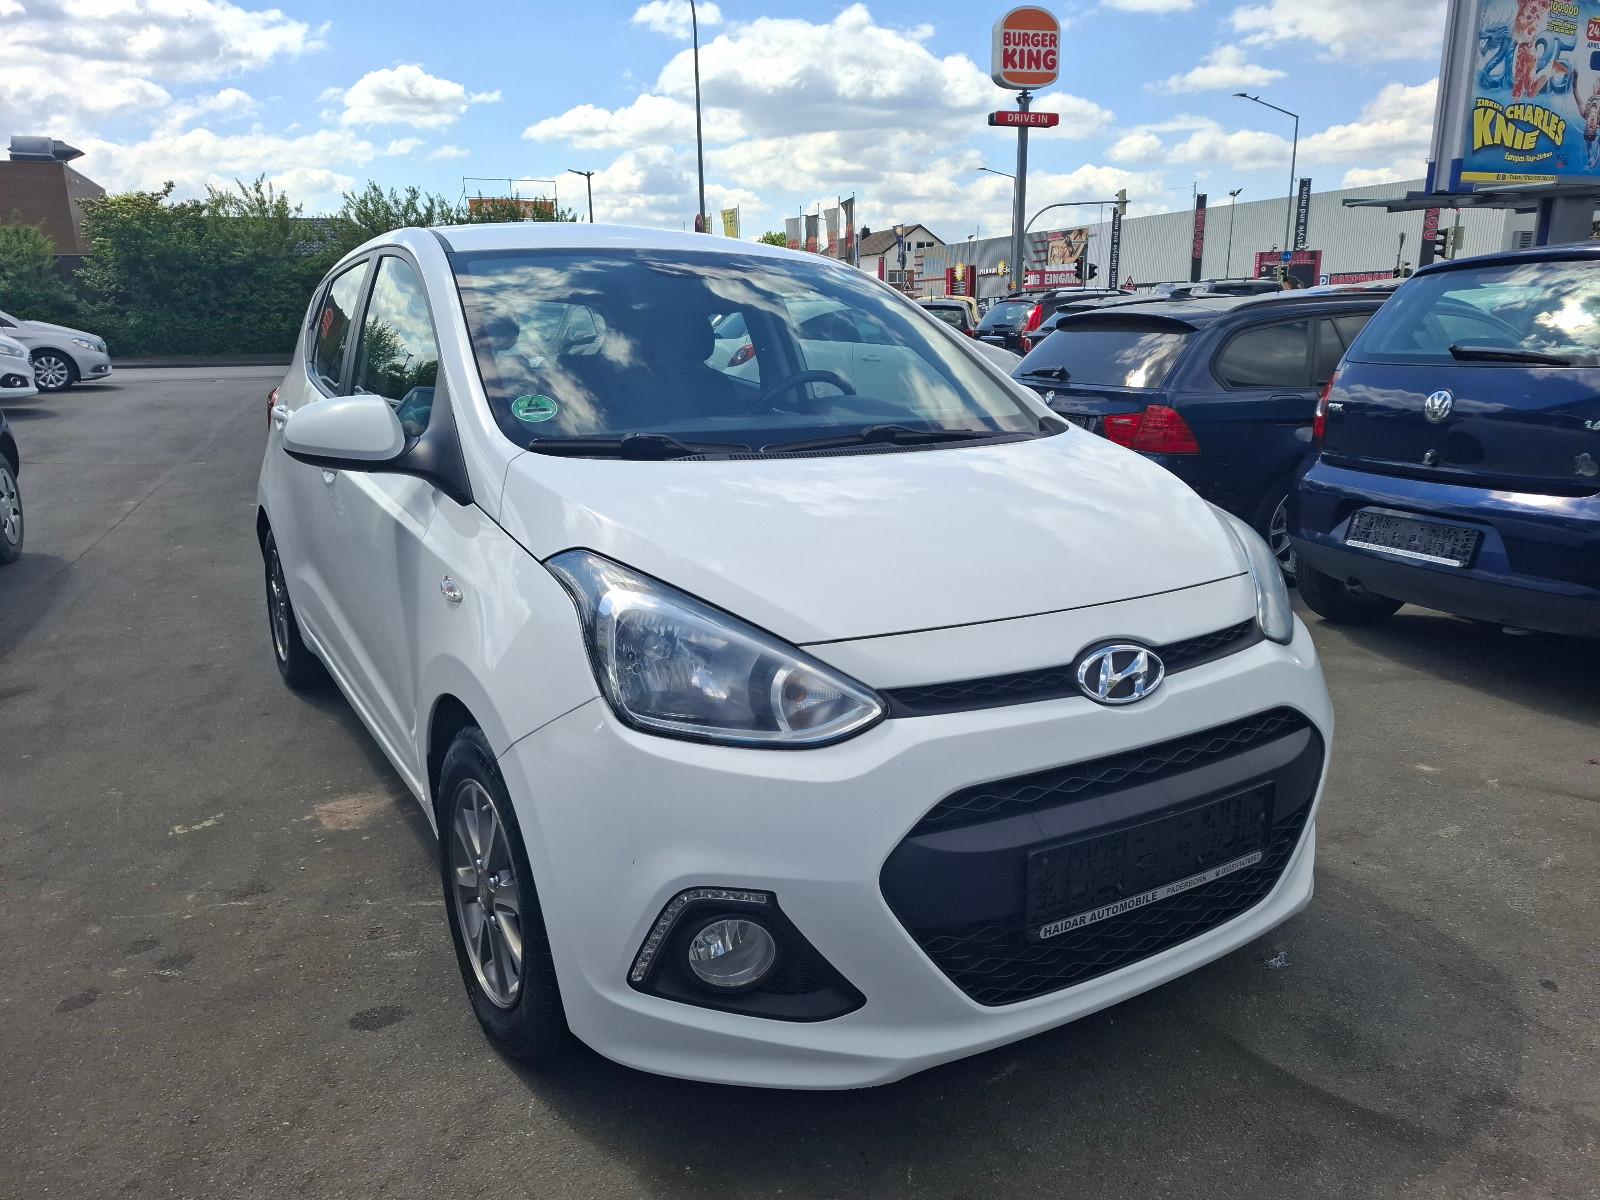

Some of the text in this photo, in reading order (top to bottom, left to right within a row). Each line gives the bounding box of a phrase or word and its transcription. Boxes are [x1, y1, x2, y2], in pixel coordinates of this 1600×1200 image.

[1003, 31, 1058, 48] BURGER
[1002, 47, 1057, 71] KING
[1007, 113, 1048, 123] DRIVE IN
[1473, 107, 1539, 151] KNIE
[1505, 104, 1566, 146] CHARLES
[1043, 915, 1087, 937] HAIDAR
[1089, 892, 1158, 922] AUTOMOBILE
[1166, 875, 1207, 895] PADERBORN
